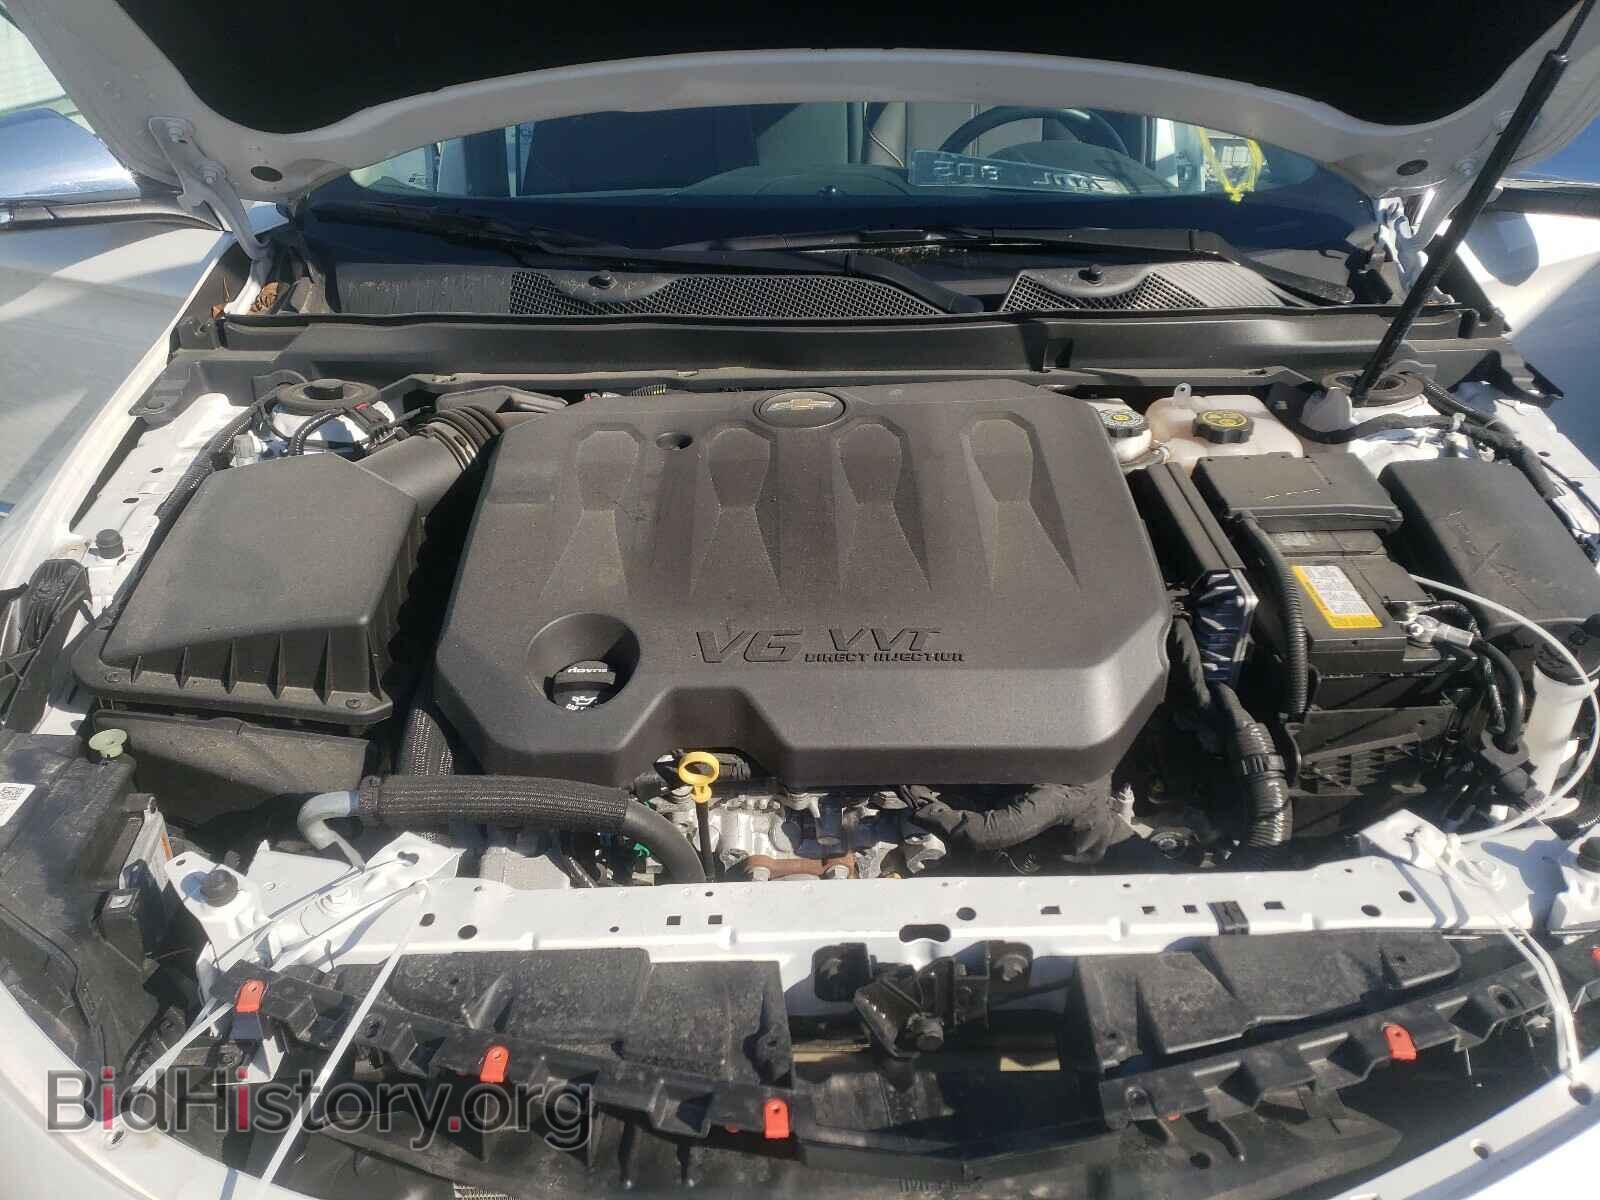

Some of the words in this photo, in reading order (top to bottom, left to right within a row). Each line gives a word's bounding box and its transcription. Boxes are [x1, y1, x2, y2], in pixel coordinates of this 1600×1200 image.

[695, 630, 803, 664] V6
[828, 627, 942, 652] VVT
[804, 652, 868, 663] DIRECT
[873, 652, 966, 663] INJECTION
